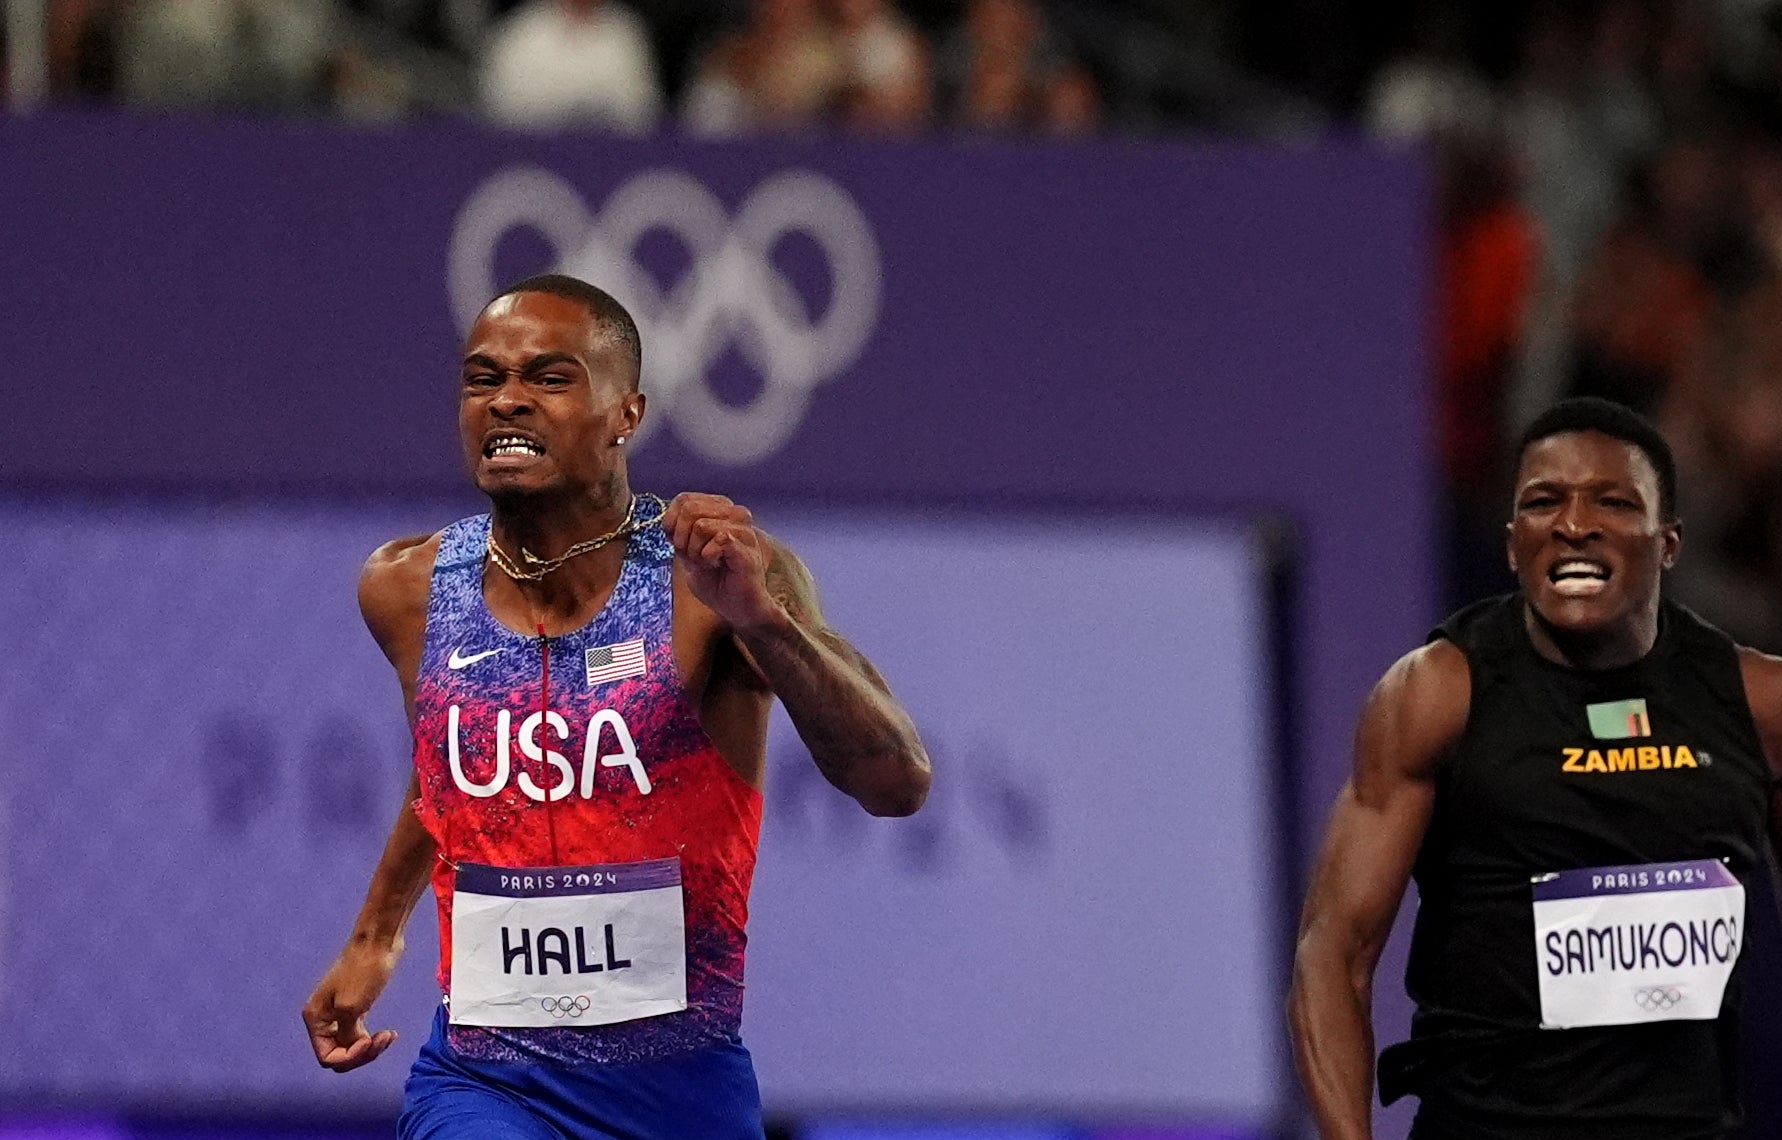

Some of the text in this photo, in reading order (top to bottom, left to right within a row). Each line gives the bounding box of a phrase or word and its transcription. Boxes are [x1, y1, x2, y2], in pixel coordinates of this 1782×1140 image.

[448, 705, 651, 801] USA
[1562, 745, 1698, 773] ZAMBIA
[501, 872, 617, 890] PARIS 2024
[1592, 868, 1706, 889] PARIS 2024
[502, 924, 632, 975] HALL
